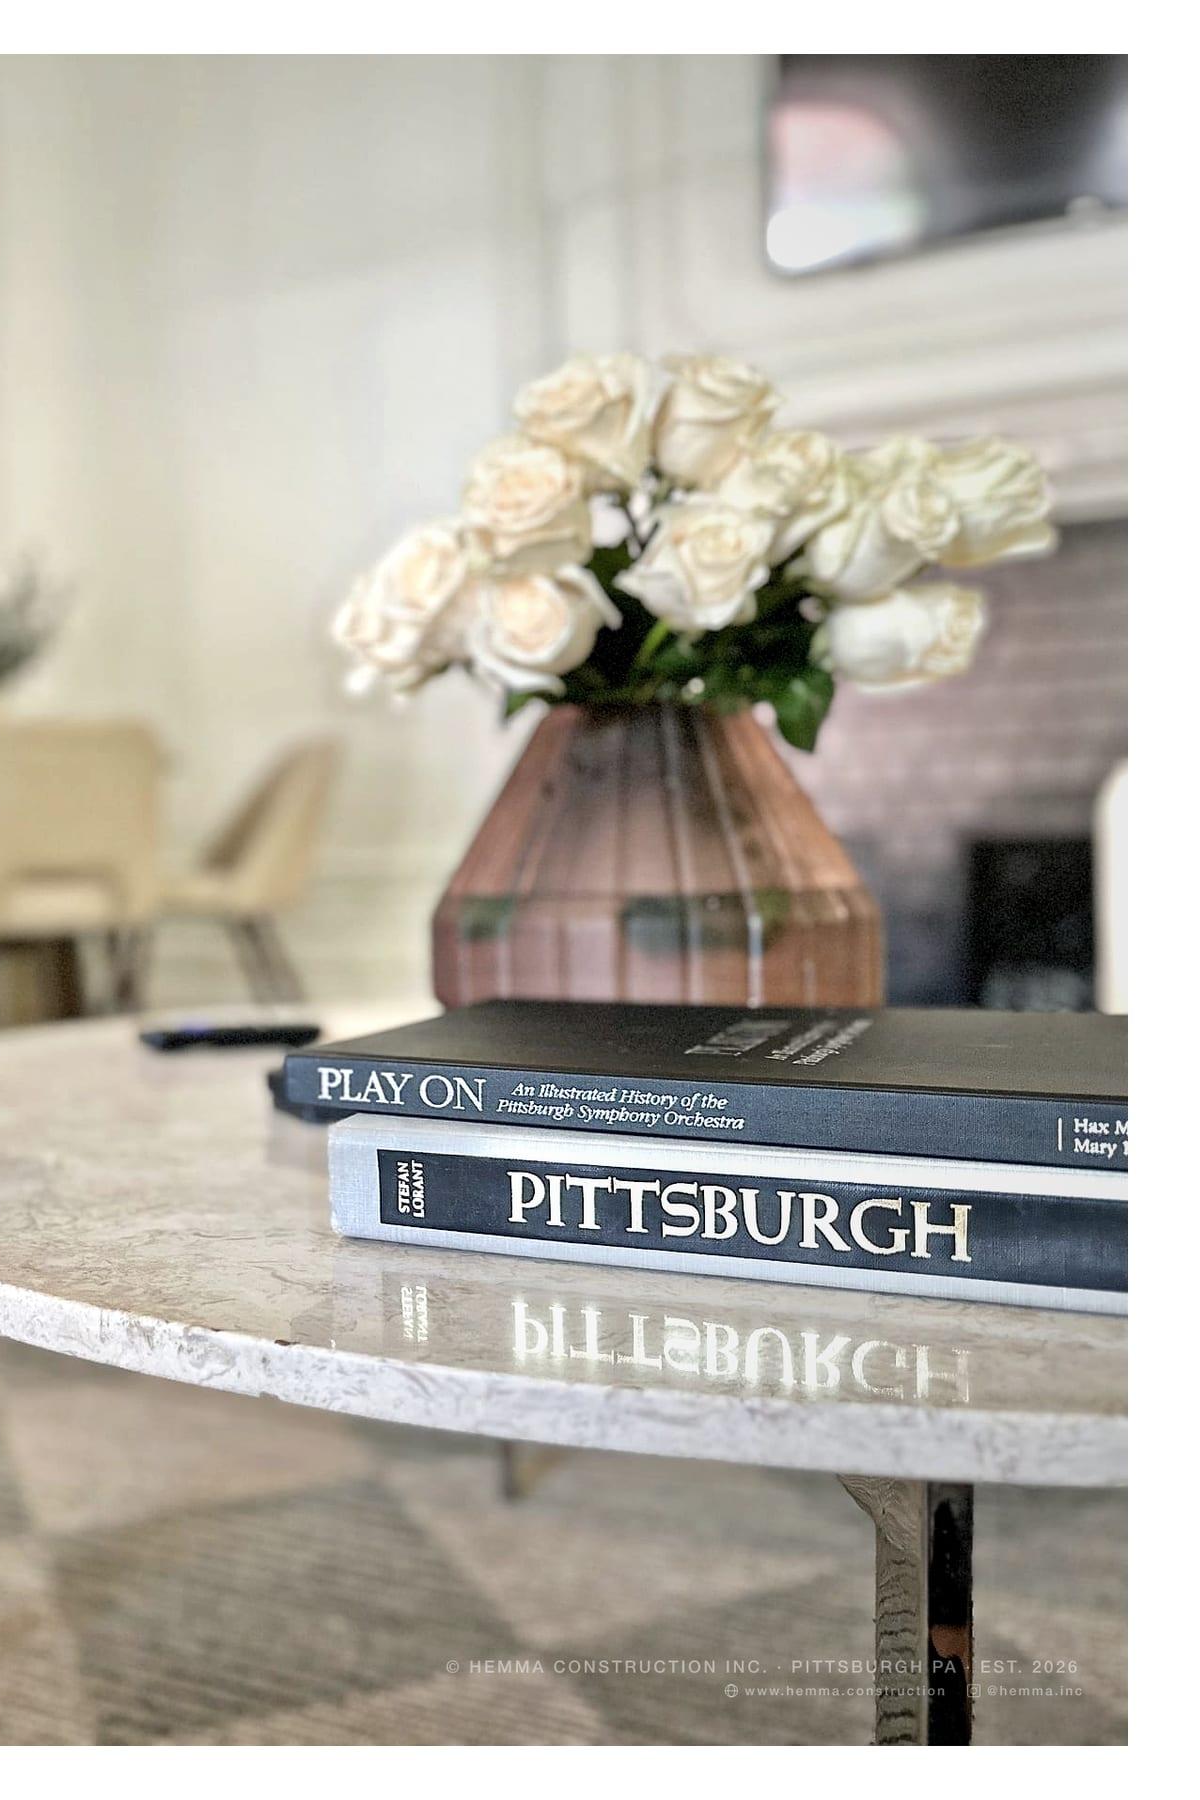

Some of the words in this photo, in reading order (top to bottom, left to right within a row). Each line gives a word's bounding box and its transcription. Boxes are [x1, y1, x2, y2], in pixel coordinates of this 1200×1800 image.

[317, 1066, 413, 1105] PLAY
[419, 1074, 487, 1112] ON
[511, 1082, 536, 1097] An
[538, 1083, 616, 1103] Illustrated
[620, 1089, 679, 1110] History
[680, 1092, 700, 1112] of
[701, 1093, 729, 1110] the
[496, 1098, 575, 1121] Pittsburgh
[577, 1105, 662, 1127] Symphony
[663, 1110, 745, 1130] Orchestra
[1073, 1117, 1110, 1135] Hax
[1073, 1137, 1118, 1160] Mary
[397, 1161, 411, 1214] STEFAN
[411, 1159, 425, 1218] LORANT
[506, 1171, 973, 1263] PITTSBURGH
